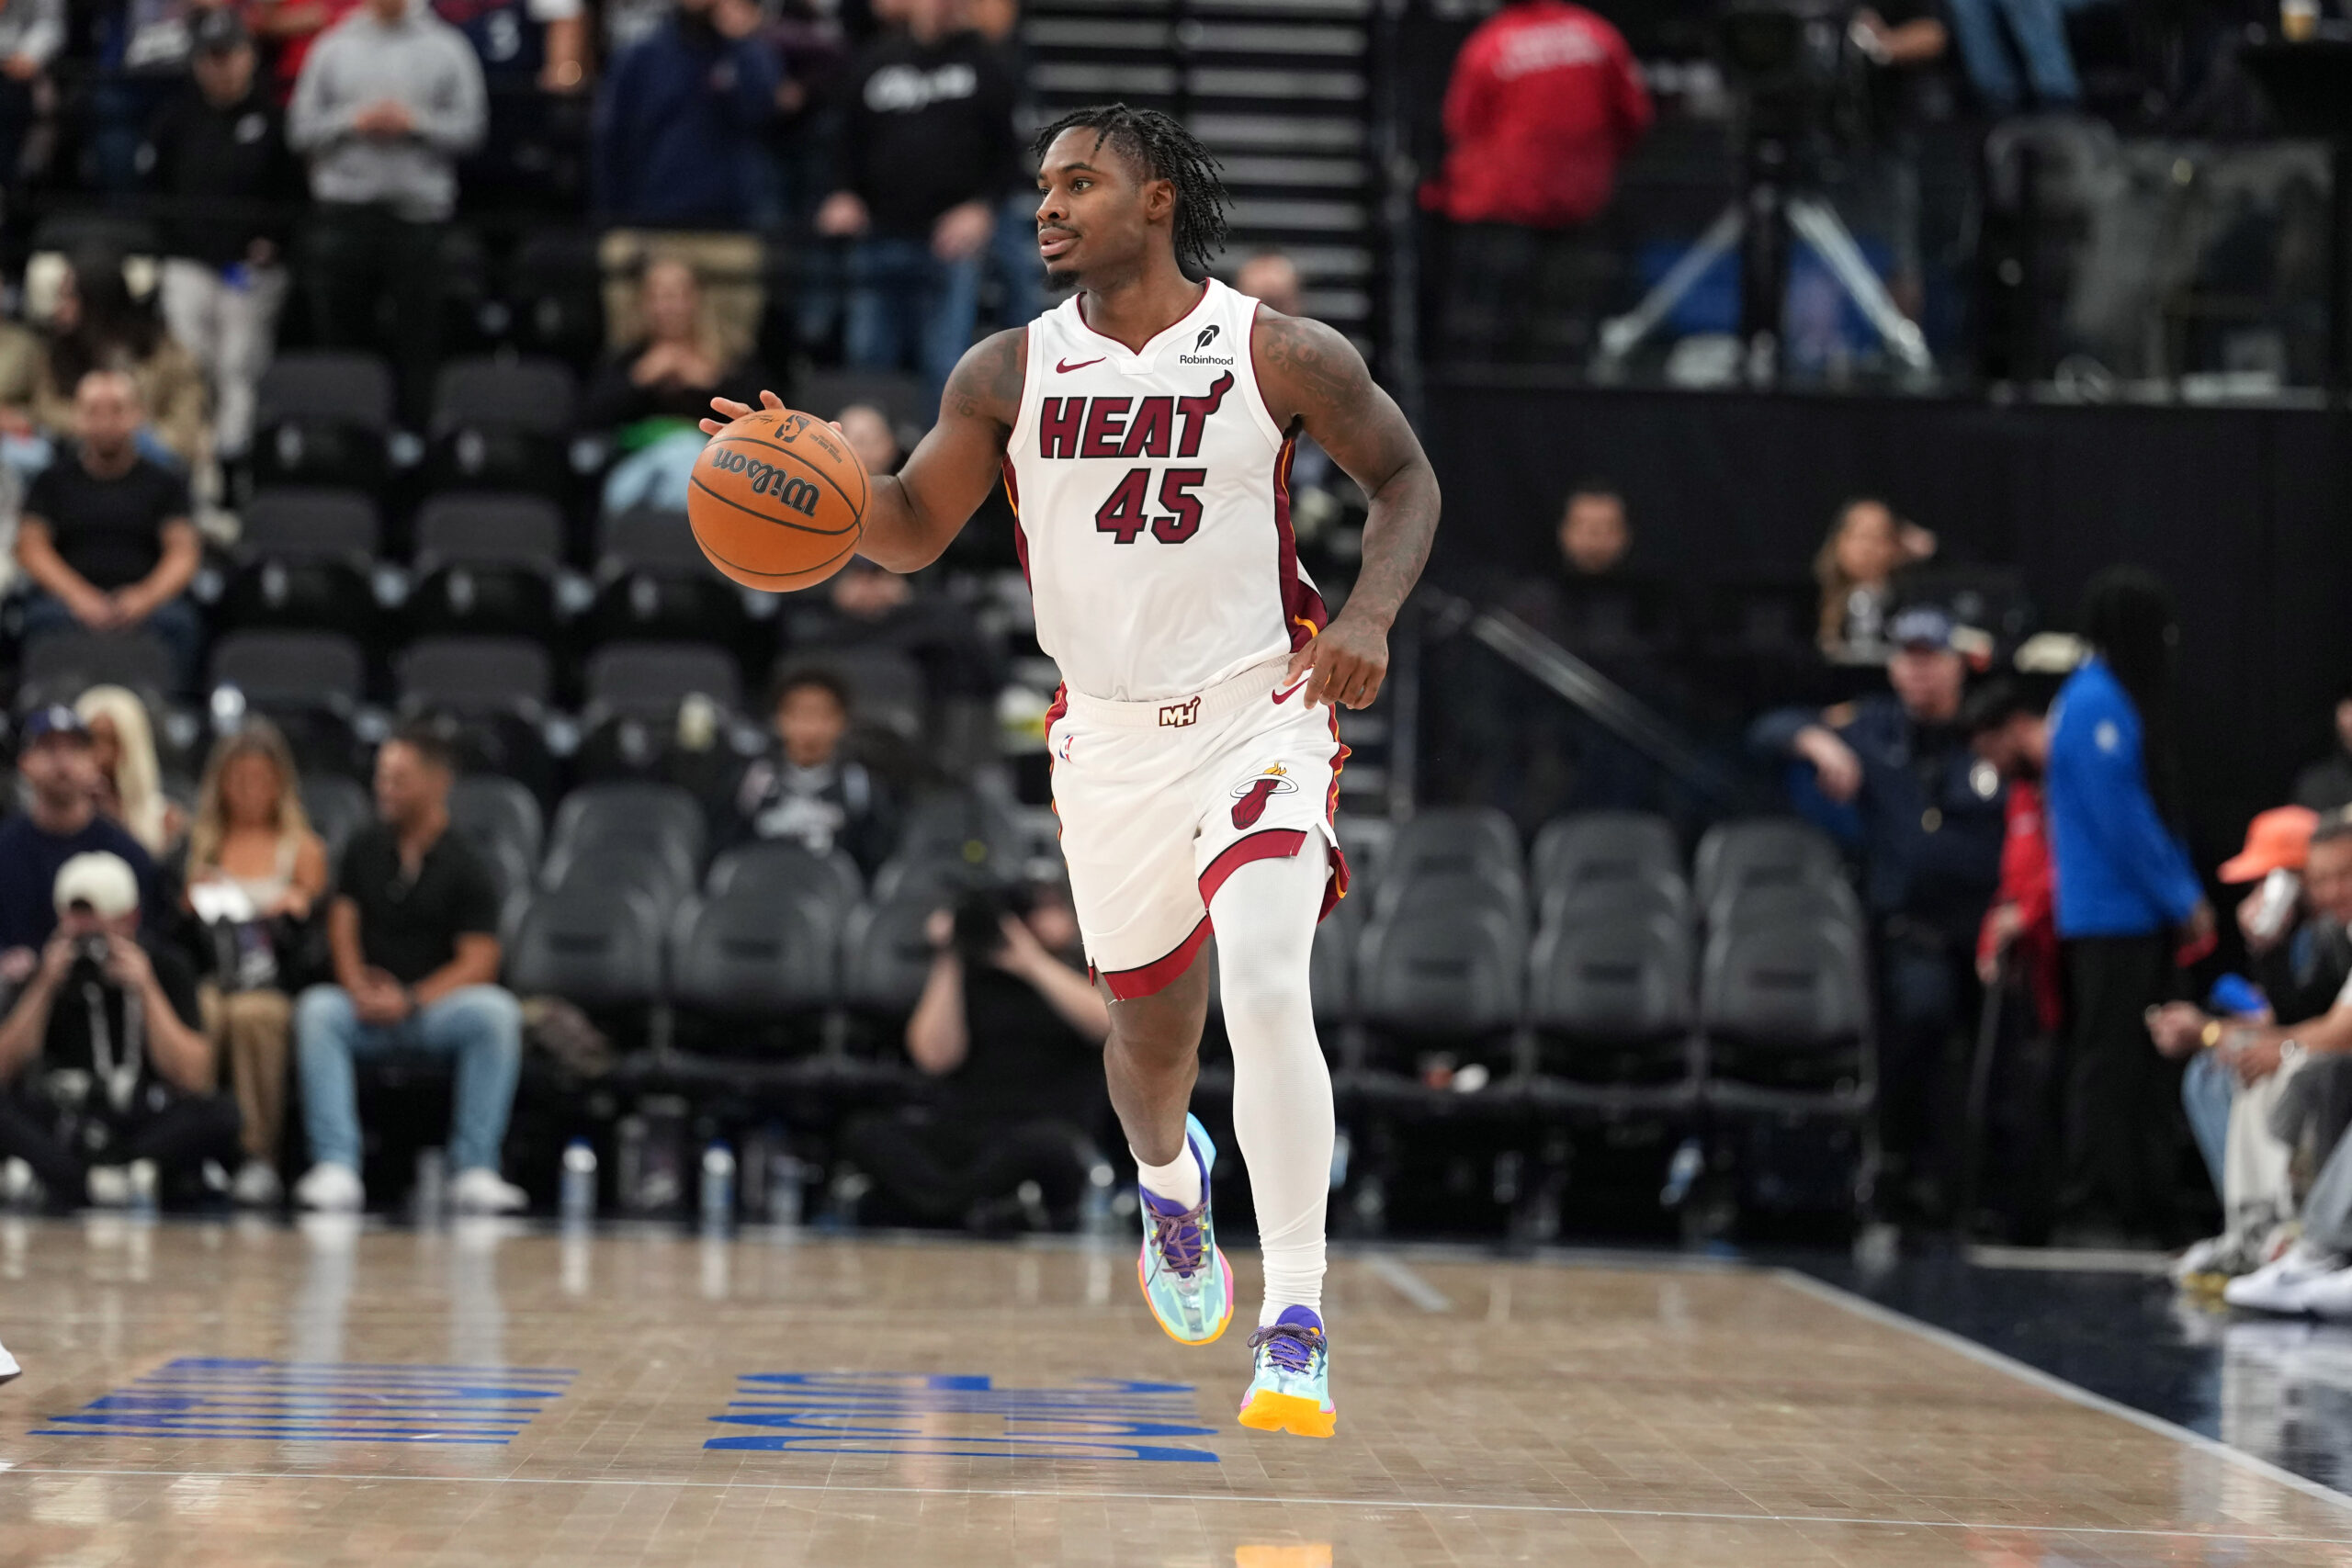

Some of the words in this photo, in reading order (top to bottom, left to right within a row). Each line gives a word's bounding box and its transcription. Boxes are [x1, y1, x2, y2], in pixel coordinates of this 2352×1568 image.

[1180, 355, 1234, 366] Robinhood
[1040, 369, 1235, 459] HEAT
[712, 447, 820, 517] Wilson
[1095, 468, 1207, 544] 45
